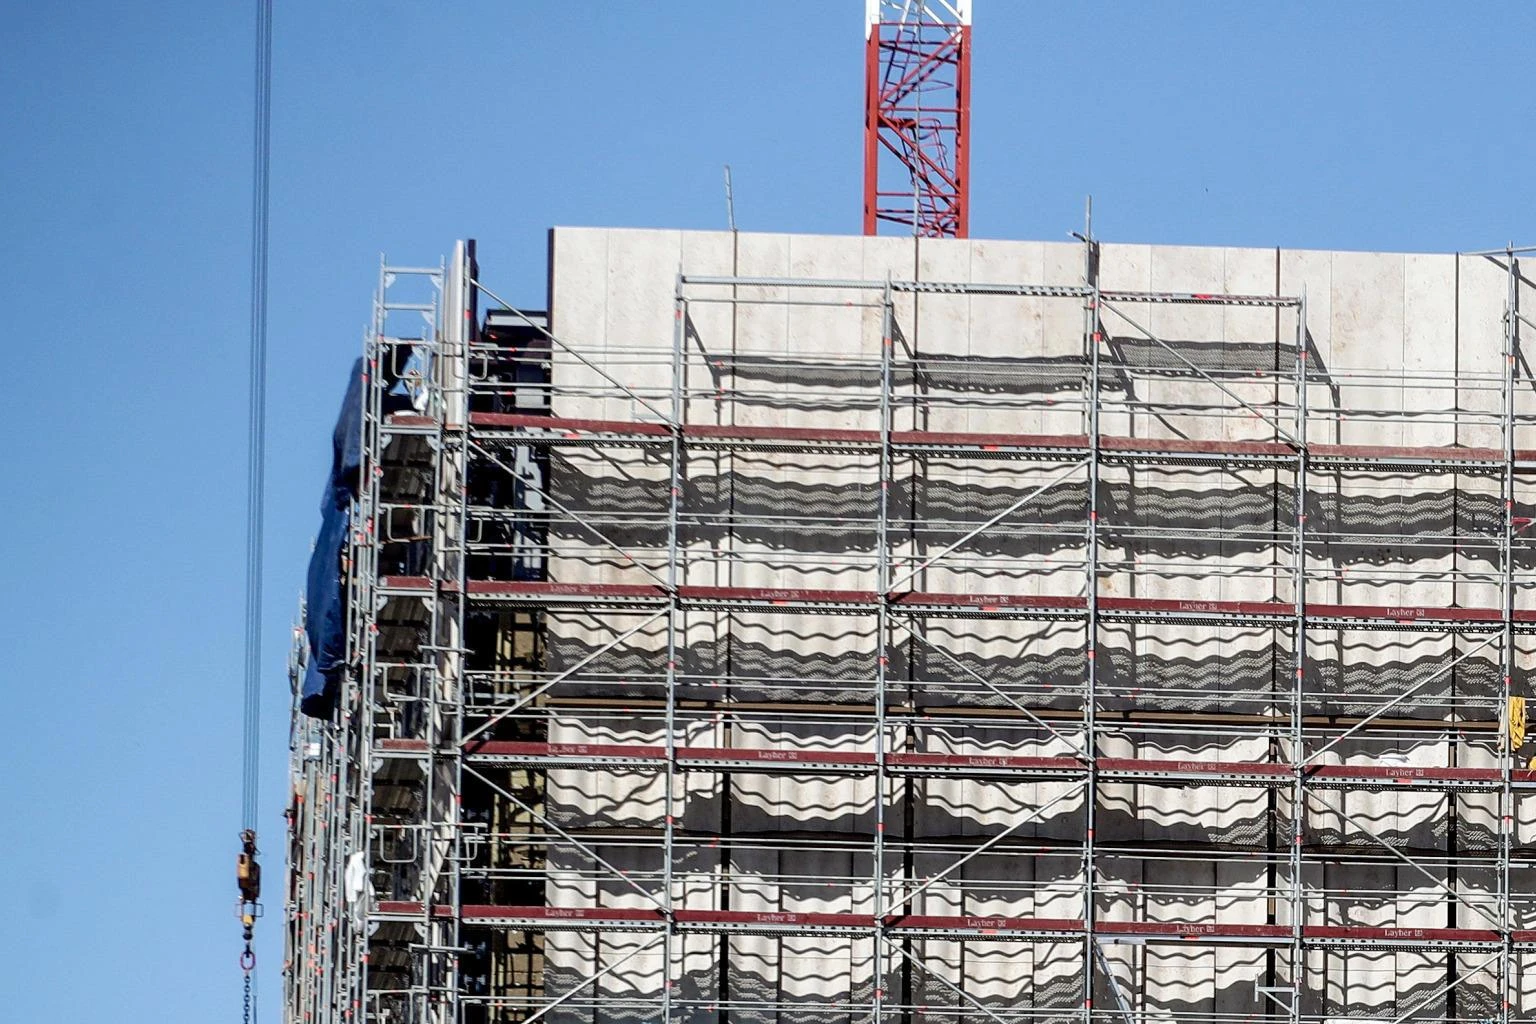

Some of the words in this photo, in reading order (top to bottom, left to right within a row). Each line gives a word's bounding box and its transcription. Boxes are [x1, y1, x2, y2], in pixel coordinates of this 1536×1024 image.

[970, 595, 998, 605] Layher
[1387, 608, 1415, 617] Layher
[759, 751, 787, 760] Layher
[1386, 768, 1414, 778] Layher
[546, 908, 574, 918] Layher
[757, 913, 785, 923] Layher
[967, 919, 995, 928] Layher
[1385, 928, 1413, 938] Layher
